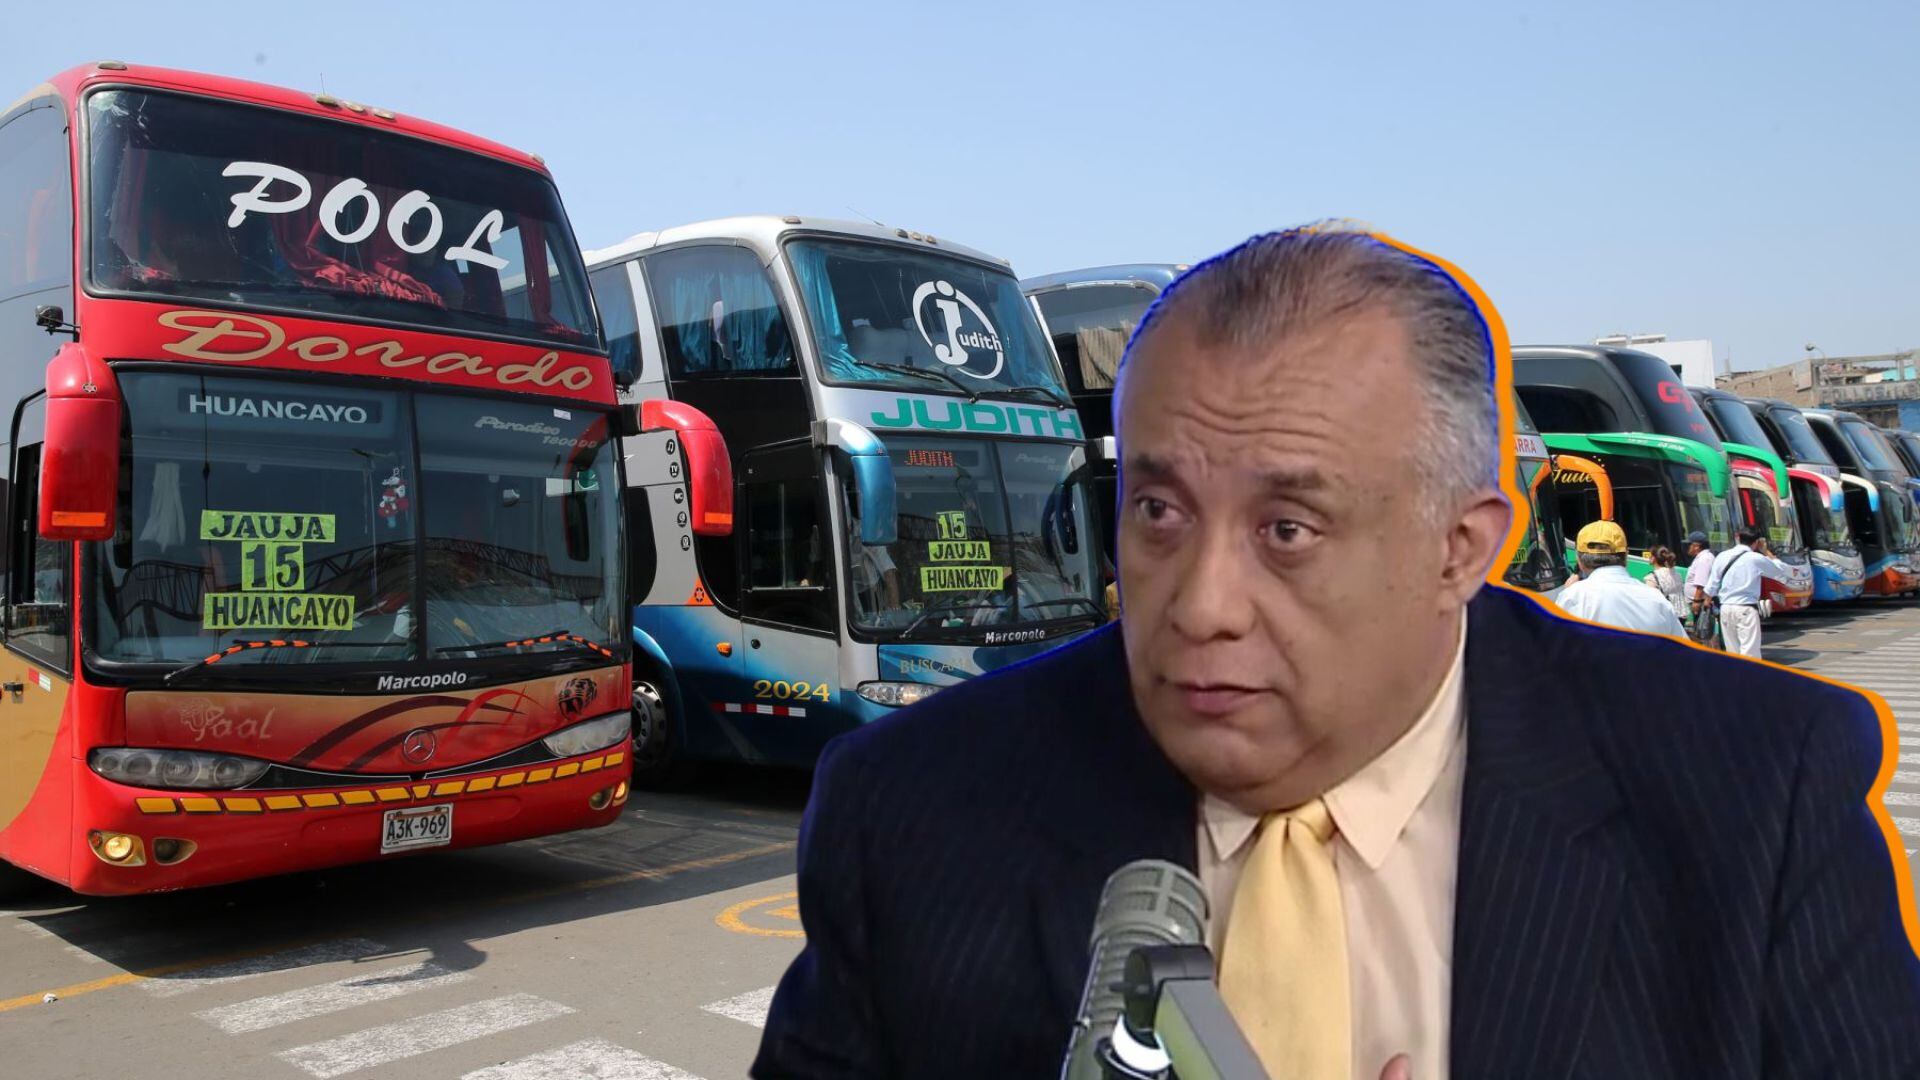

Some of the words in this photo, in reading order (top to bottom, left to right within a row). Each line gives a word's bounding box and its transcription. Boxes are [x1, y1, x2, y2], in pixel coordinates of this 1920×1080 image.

[222, 161, 510, 270] POOL
[158, 310, 593, 390] Dorado
[189, 394, 368, 424] HUANCAYO
[871, 398, 1083, 440] JUDITH
[904, 449, 954, 467] JUDITH
[209, 515, 326, 540] JAUJA
[938, 513, 966, 539] 15
[933, 543, 987, 560] JAUJA
[246, 544, 301, 588] 15
[927, 569, 998, 590] HUANCAYO
[212, 596, 350, 627] HUANCAYO
[985, 628, 1046, 644] Marcopolo
[377, 671, 468, 691] Marcopolo
[753, 680, 830, 703] 2024
[386, 814, 446, 841] A3K-969
